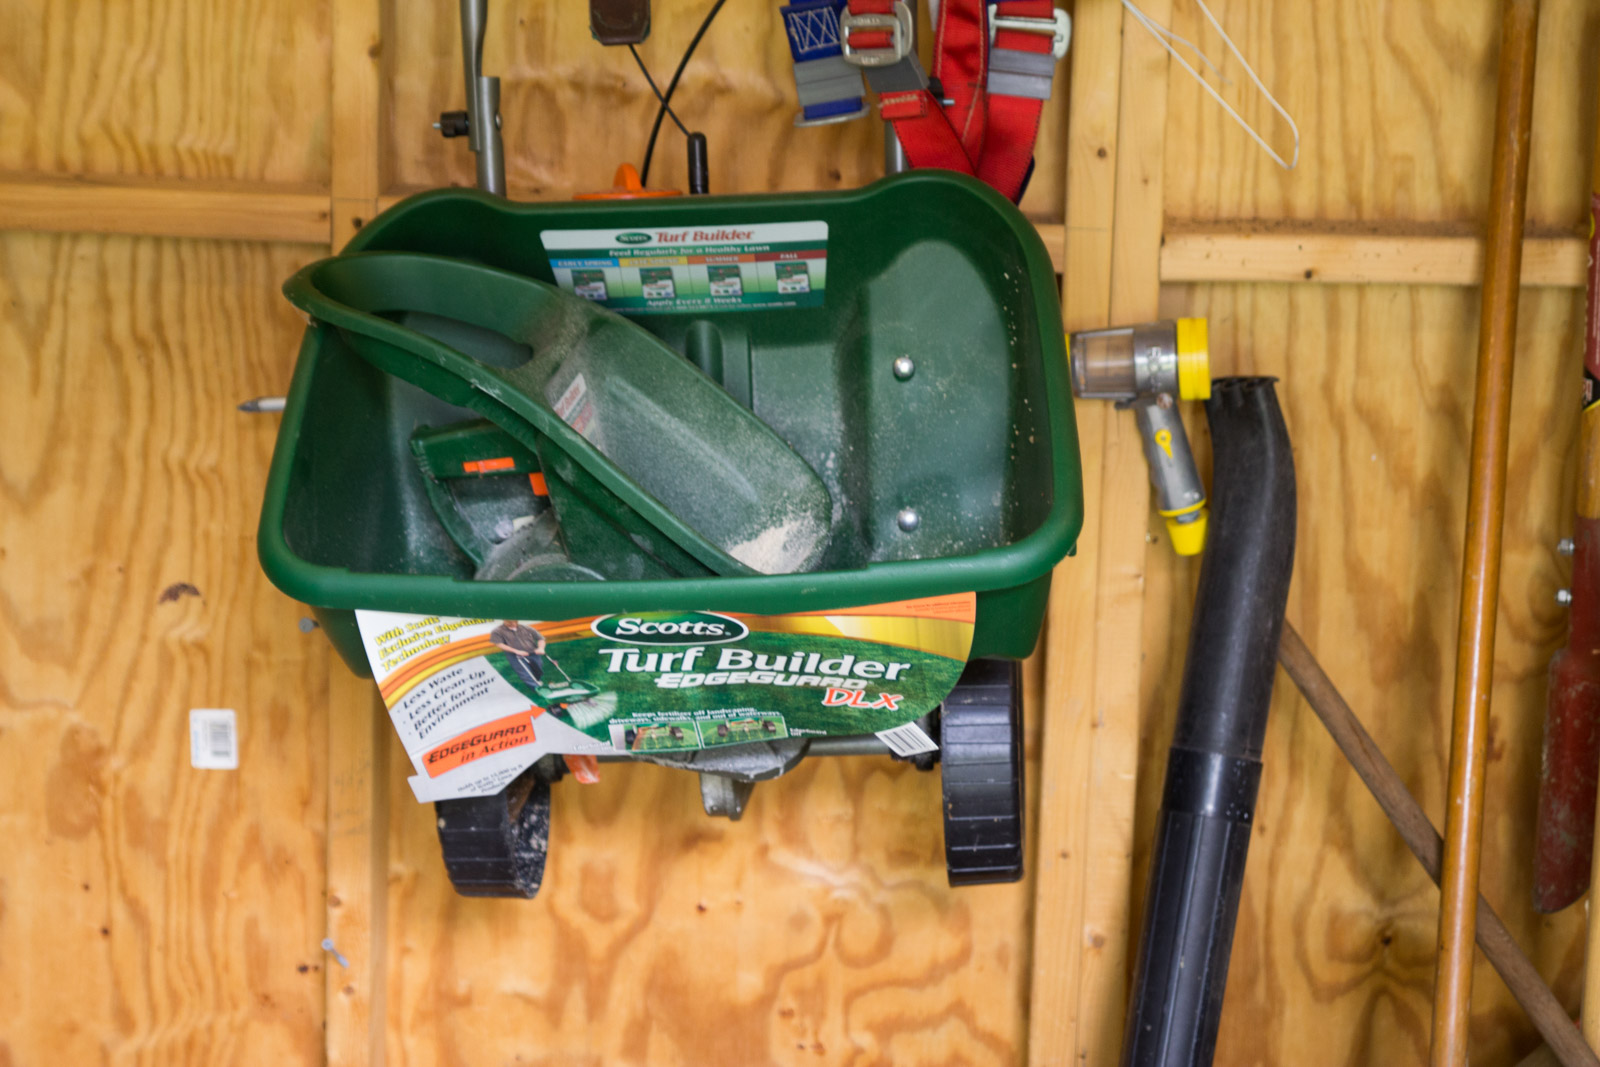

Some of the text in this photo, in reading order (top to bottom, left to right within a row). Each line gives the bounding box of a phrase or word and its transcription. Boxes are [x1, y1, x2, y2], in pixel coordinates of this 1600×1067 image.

[609, 249, 632, 257] Feed
[633, 246, 678, 257] Regularly
[680, 246, 694, 255] for
[705, 244, 742, 254] Healthy
[656, 229, 754, 244] Turf Builder
[374, 616, 441, 645] With Scotts
[379, 629, 433, 659] Exclusive
[383, 635, 451, 672] Technology
[598, 647, 912, 681] Turf Builder
[403, 667, 463, 709] Less Waste
[821, 686, 905, 711] DLX
[409, 700, 432, 720] Less
[414, 675, 496, 731] Better for your
[418, 687, 489, 739] Environment
[461, 736, 529, 763] in Action
